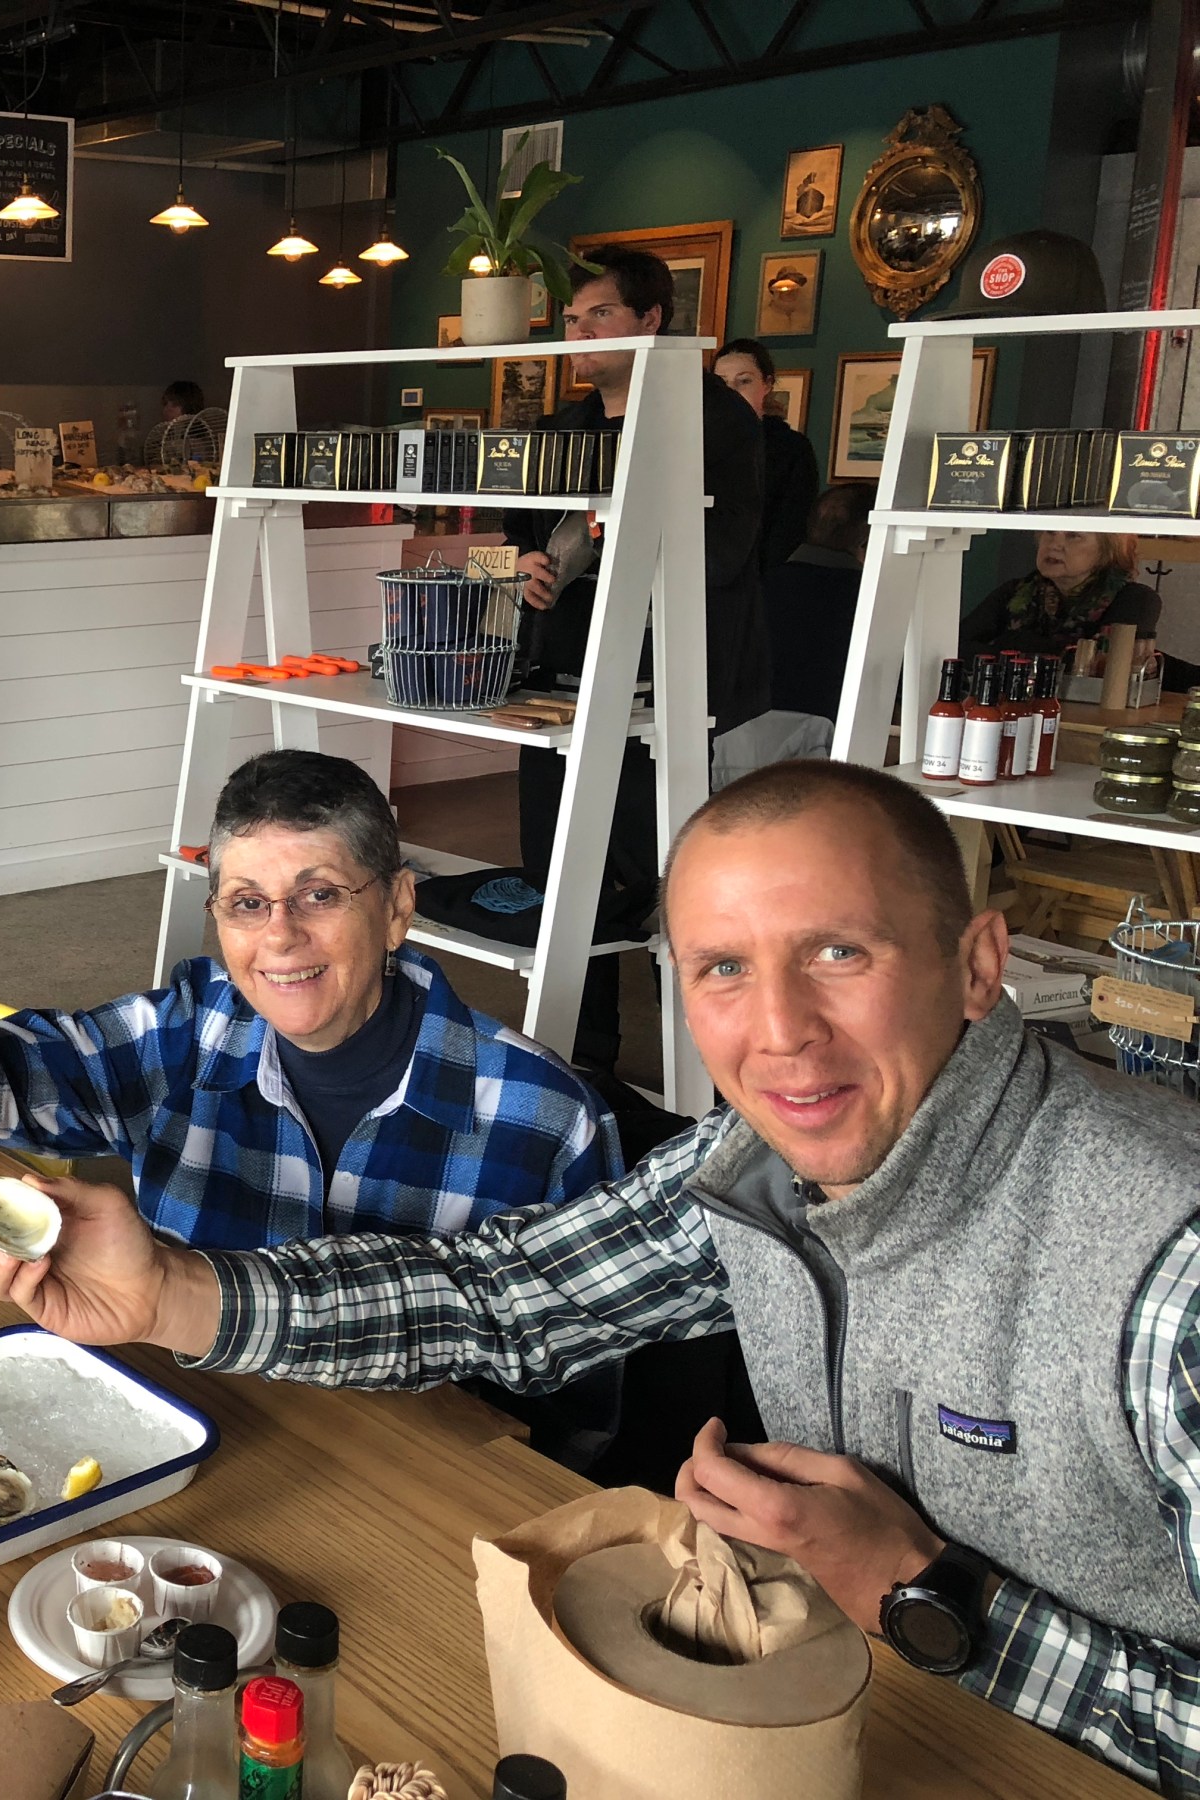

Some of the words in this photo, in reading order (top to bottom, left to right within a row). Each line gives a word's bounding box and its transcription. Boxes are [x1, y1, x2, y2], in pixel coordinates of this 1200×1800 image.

[989, 271, 1016, 284] SHOP
[16, 430, 40, 440] LONG
[950, 470, 985, 478] OCTOPUS
[471, 550, 513, 569] KOOZIE
[1033, 989, 1079, 1005] American
[942, 1423, 1004, 1448] patagonia
